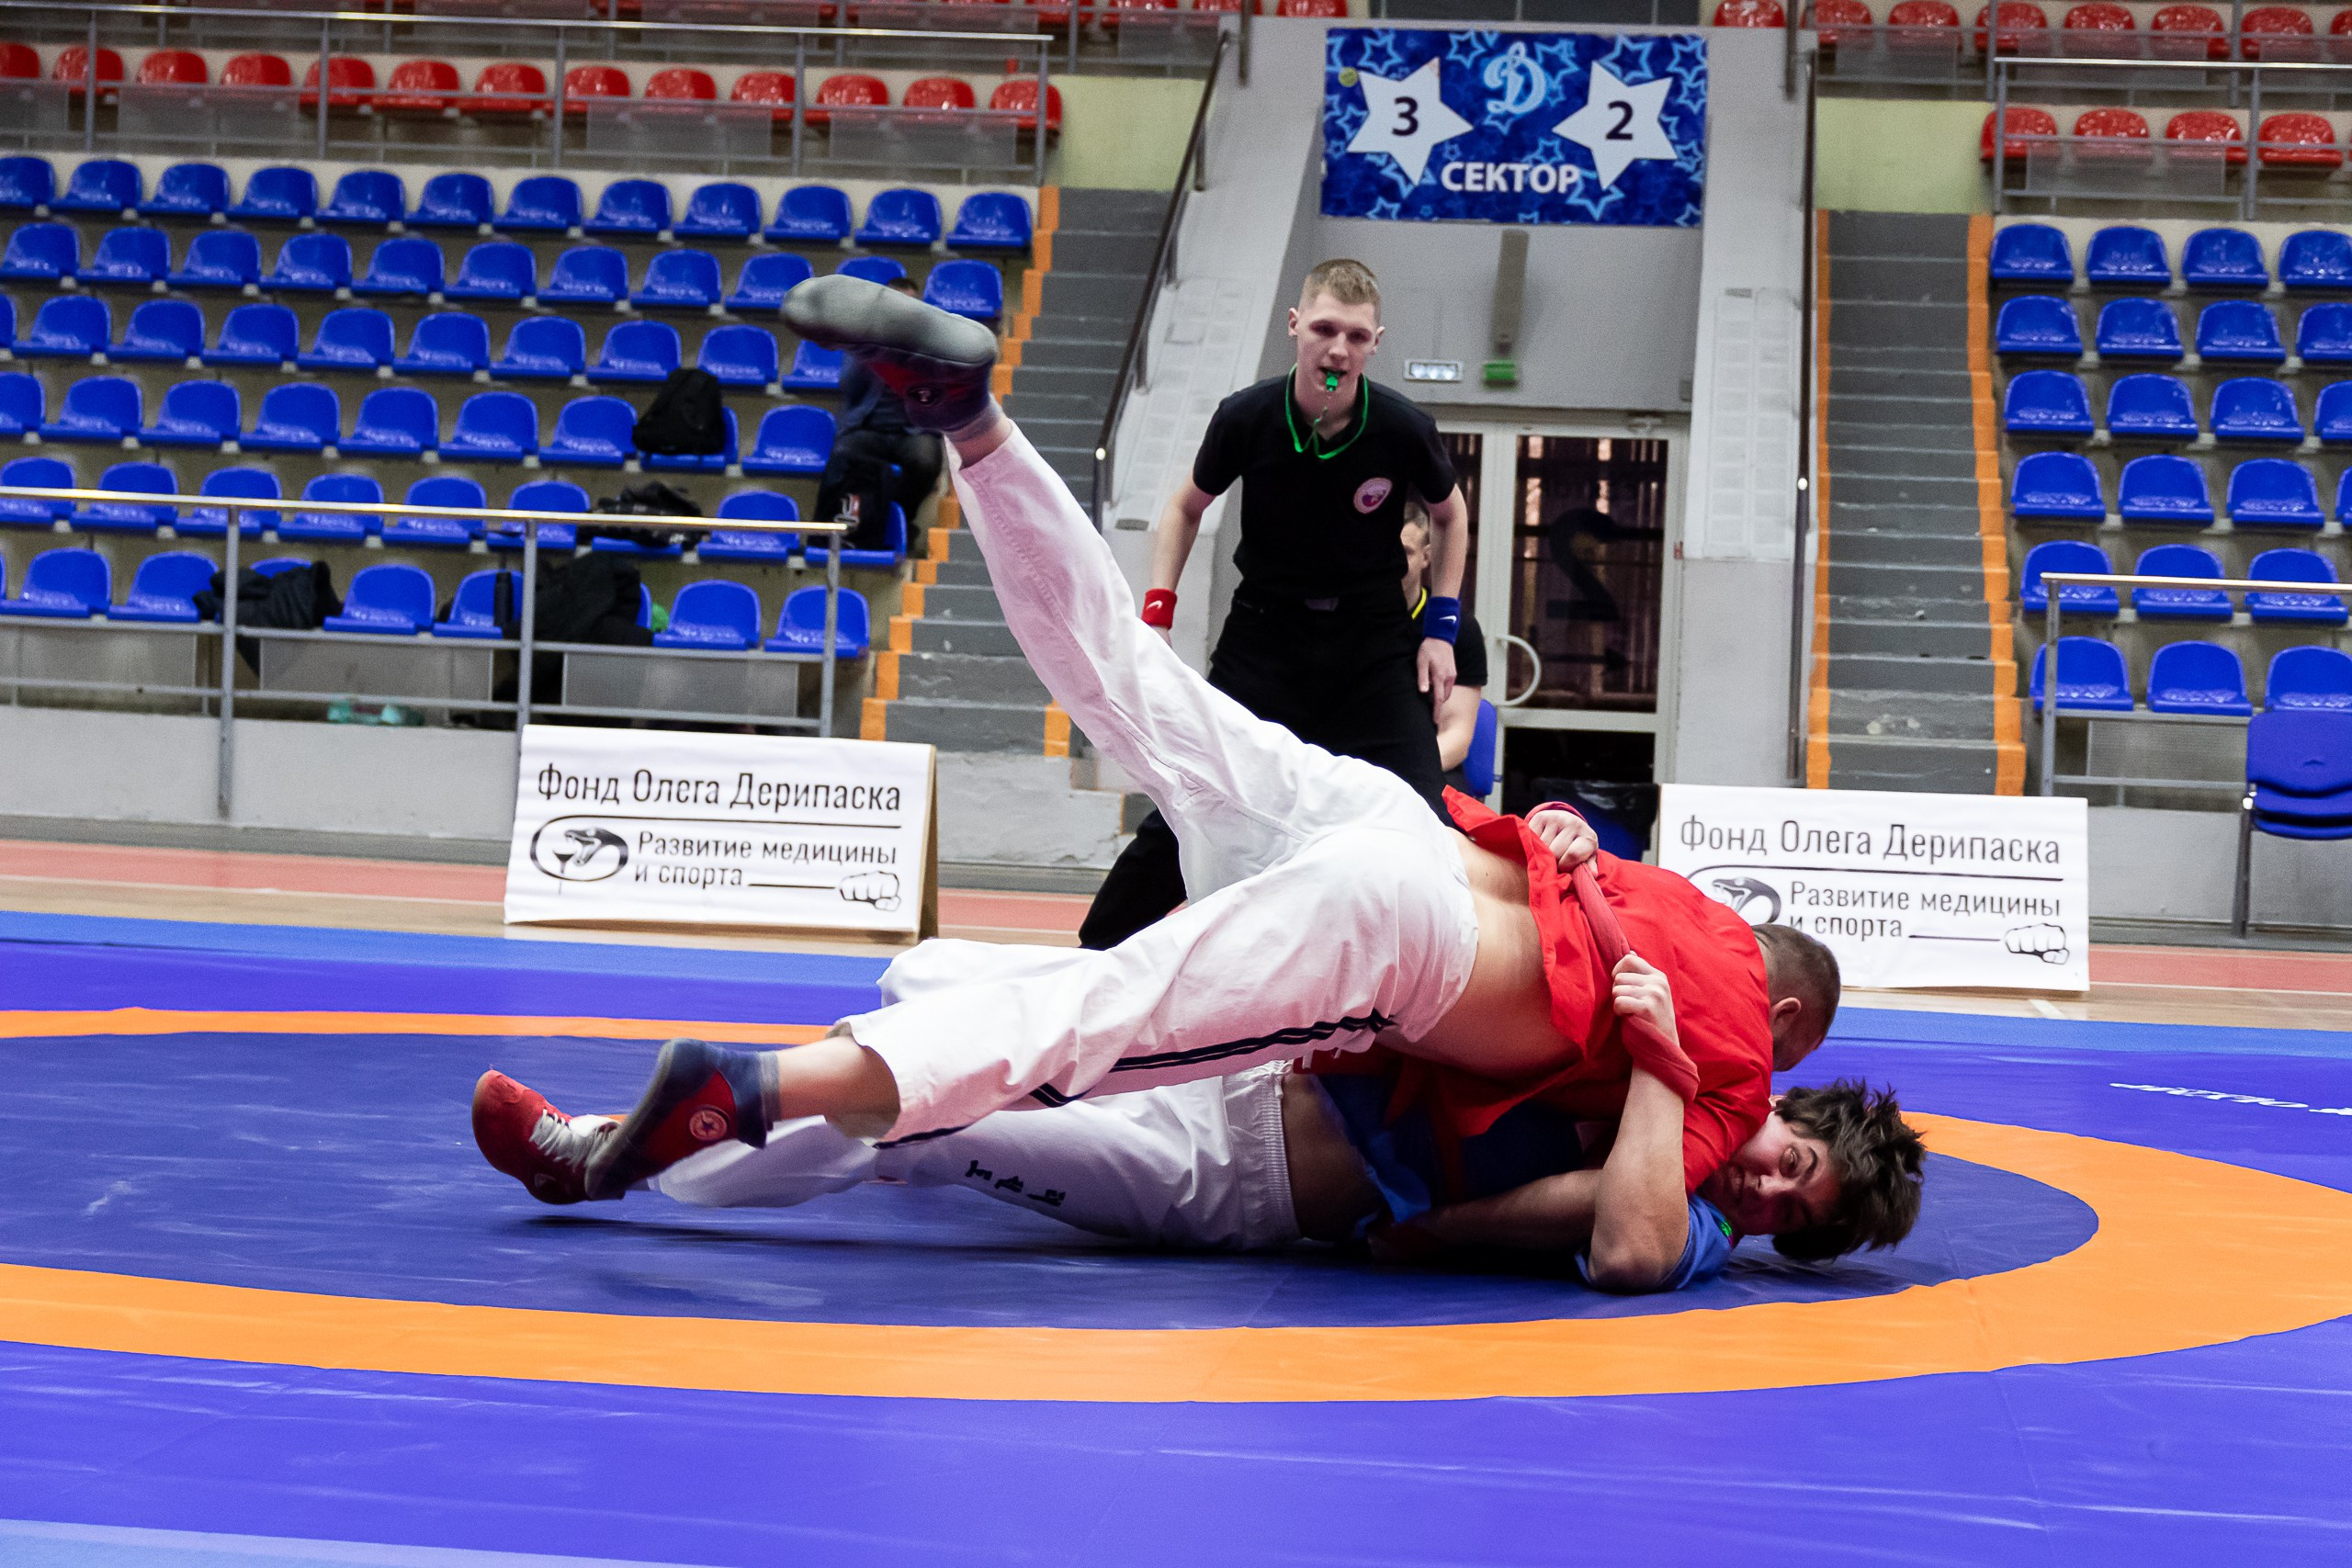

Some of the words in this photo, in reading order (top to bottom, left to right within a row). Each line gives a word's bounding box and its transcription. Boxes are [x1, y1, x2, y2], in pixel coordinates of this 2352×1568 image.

[1391, 96, 1419, 137] 3
[1605, 101, 1634, 141] 2
[1442, 162, 1579, 194] СЕКТОР
[538, 762, 620, 805] Фонд
[633, 769, 719, 805] Олега
[729, 772, 901, 813] Дерипаска
[638, 830, 752, 859] Развитие
[762, 840, 897, 864] медицины
[1680, 815, 1767, 855] Фонд
[1781, 820, 1871, 855] Олега
[1883, 824, 2060, 865] Дерипаска
[634, 865, 648, 883] и
[658, 864, 743, 890] спорта
[1790, 881, 1909, 911] Развитие
[1920, 893, 2061, 918] медицины
[1790, 916, 1803, 931] и
[1815, 916, 1902, 942] спорта
